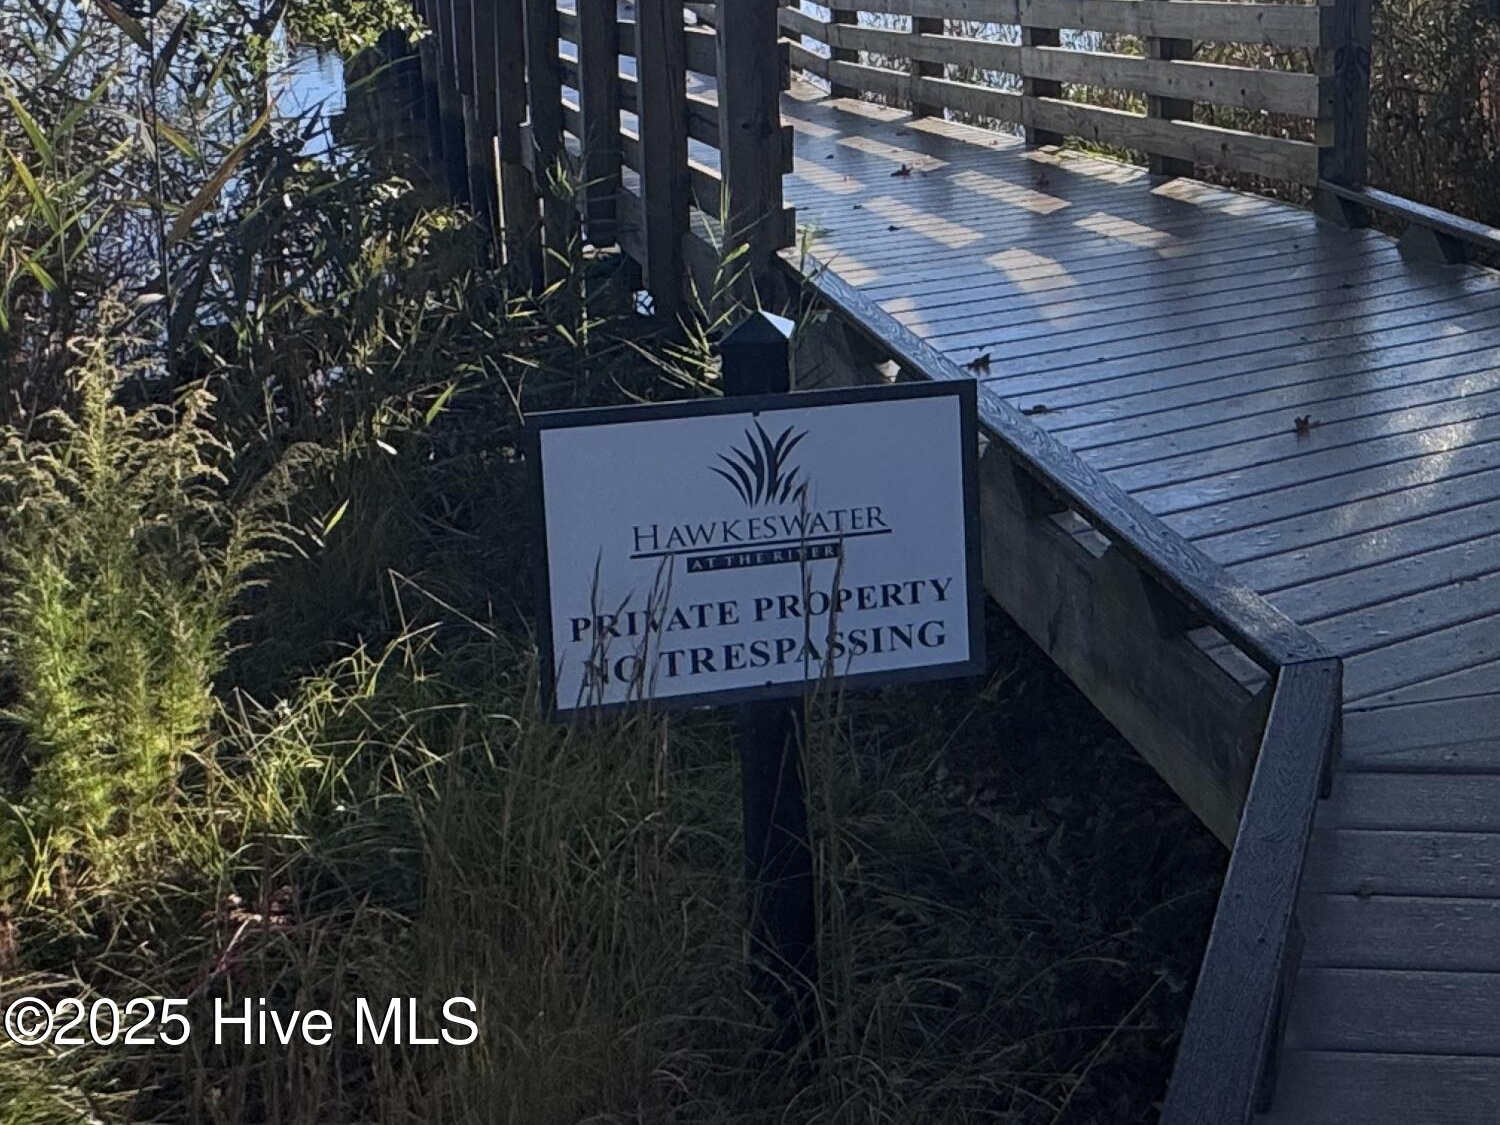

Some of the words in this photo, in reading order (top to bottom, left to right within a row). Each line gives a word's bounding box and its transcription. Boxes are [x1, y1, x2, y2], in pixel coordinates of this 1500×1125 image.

[633, 506, 887, 554] HAWKESWATER
[692, 558, 717, 571] AT
[722, 551, 764, 568] THE
[570, 601, 739, 643] PRIVATE
[755, 577, 953, 622] PROPERTY
[659, 620, 947, 678] TRESPASSING
